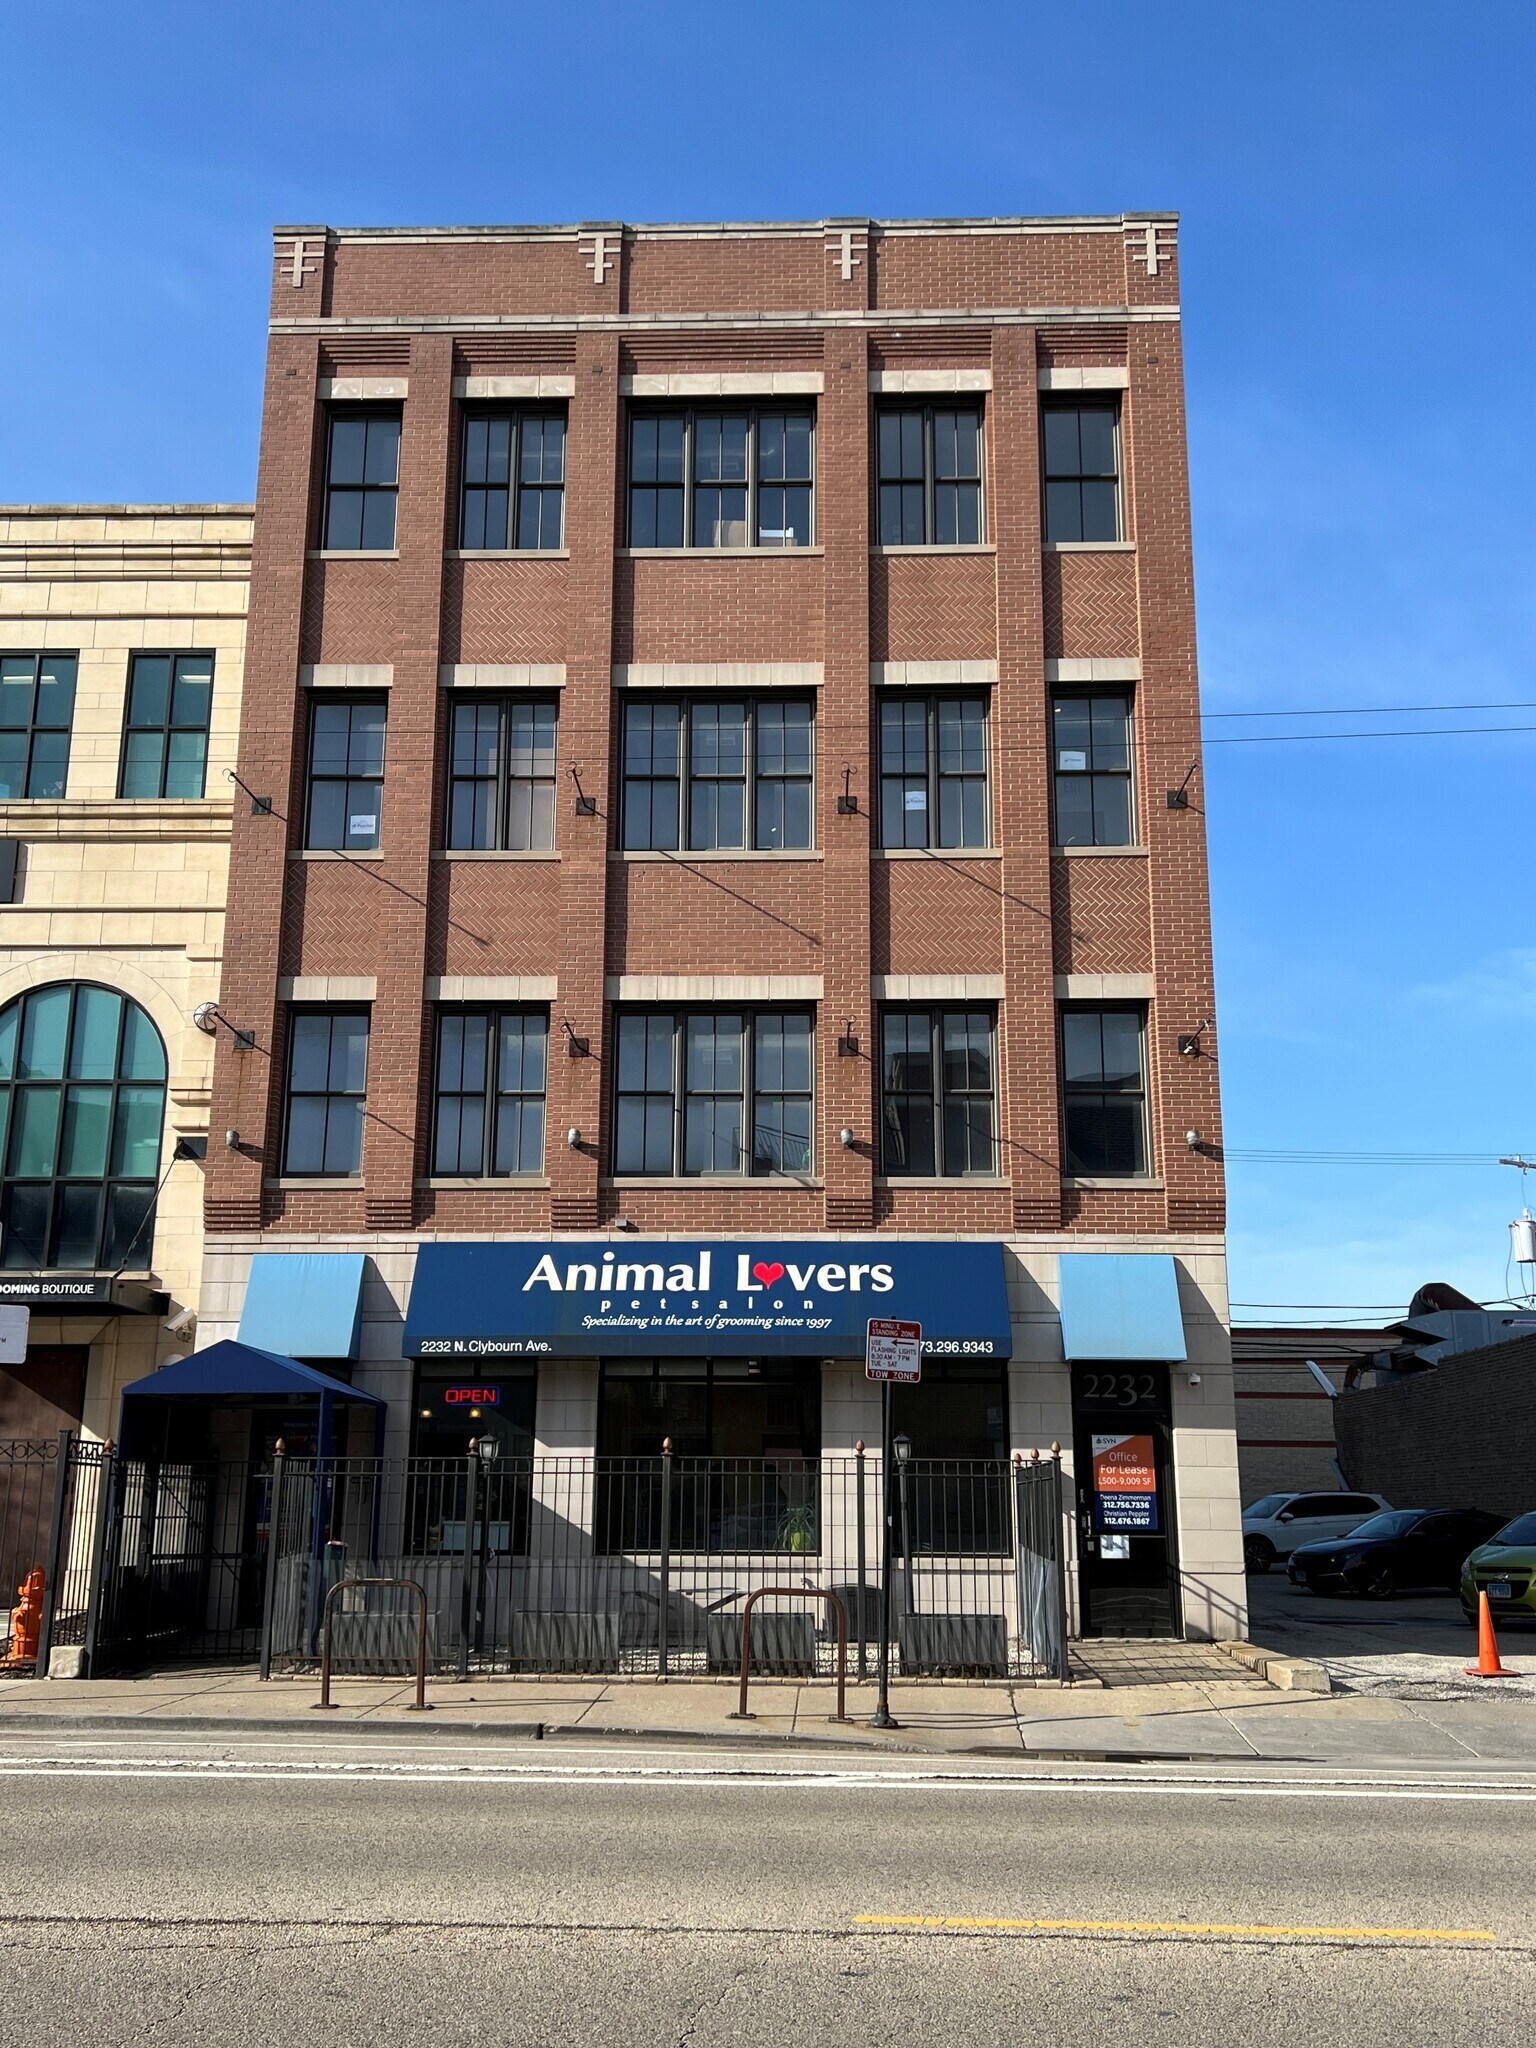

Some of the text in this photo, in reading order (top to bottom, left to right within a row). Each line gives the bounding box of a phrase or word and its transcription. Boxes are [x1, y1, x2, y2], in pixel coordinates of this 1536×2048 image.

[522, 1251, 711, 1292] Animal
[42, 1284, 95, 1294] BOUTIQUE
[581, 1314, 832, 1329] Specializing in the art of grooming since 1997
[871, 1328, 916, 1338] STANDING ZONE
[420, 1340, 553, 1354] 2232 N. Clybourn Ave.
[871, 1346, 917, 1356] FLASHING LIGHTS
[920, 1341, 994, 1353] 73.296.9343
[871, 1370, 915, 1380] TOW ZONE
[1083, 1374, 1156, 1406] 2232
[445, 1389, 496, 1403] OPEN
[1109, 1451, 1138, 1462] Office
[1100, 1465, 1148, 1474] For Lease
[1102, 1501, 1150, 1509] 312.756.7336
[1104, 1517, 1150, 1525] 312.676.1867
